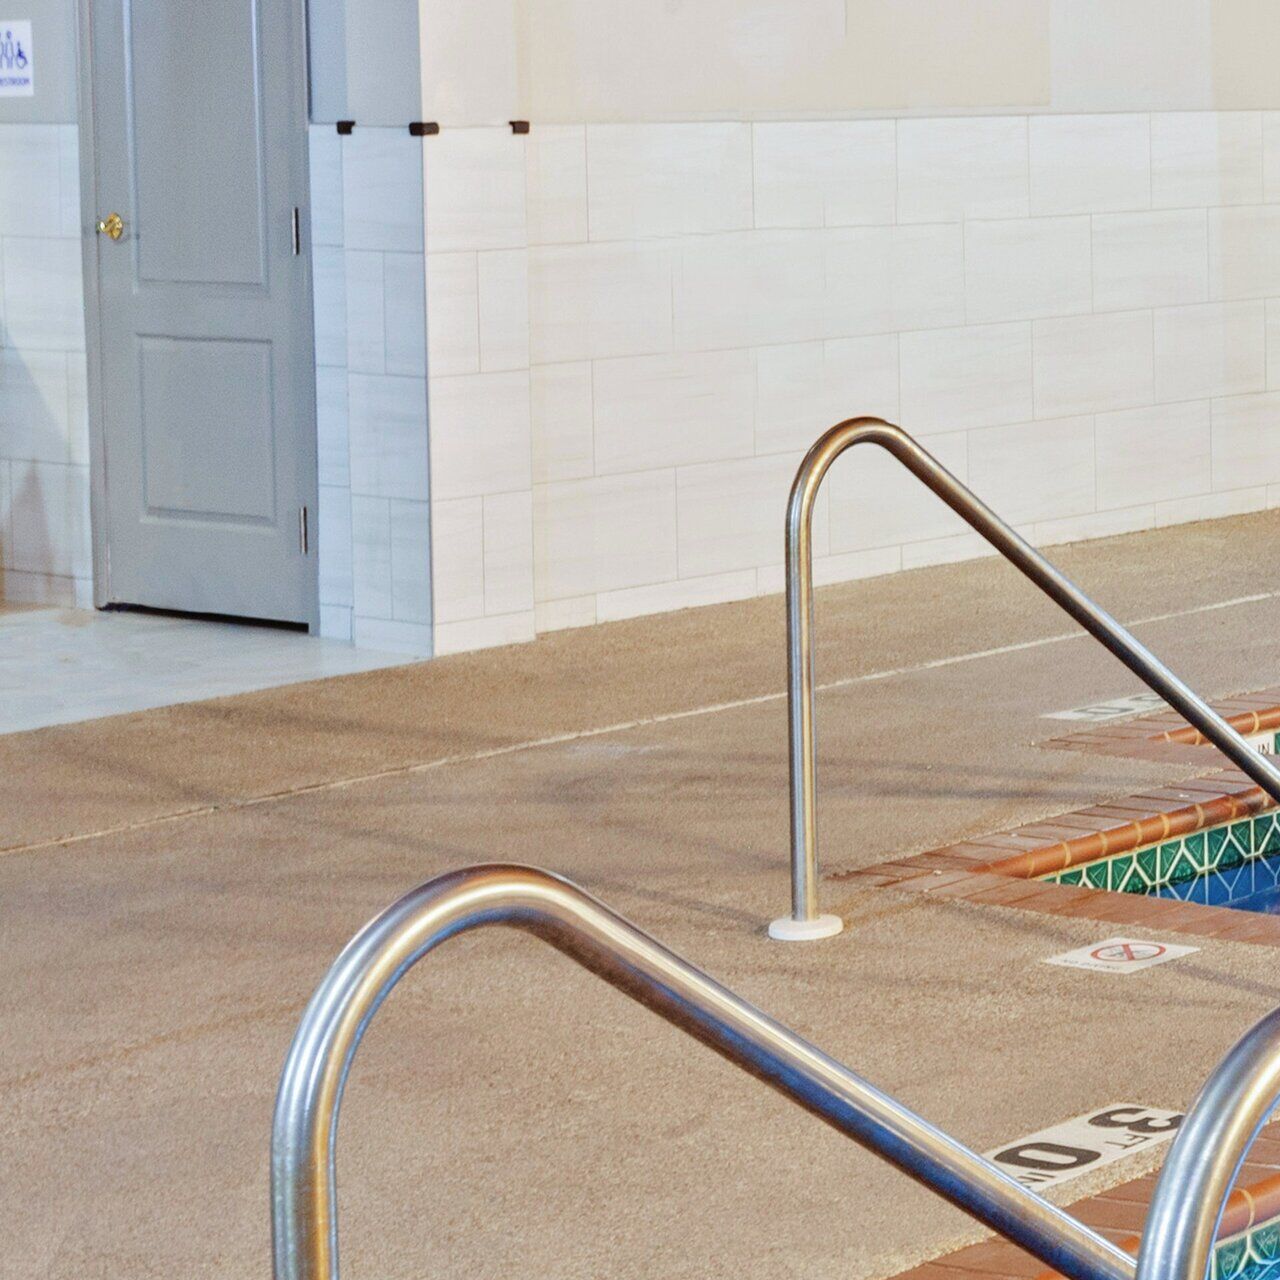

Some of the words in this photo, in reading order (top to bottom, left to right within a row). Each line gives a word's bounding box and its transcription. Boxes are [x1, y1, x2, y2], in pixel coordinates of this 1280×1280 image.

[1088, 1107, 1185, 1133] 3
[1104, 1133, 1152, 1150] FT
[993, 1142, 1102, 1171] 0
